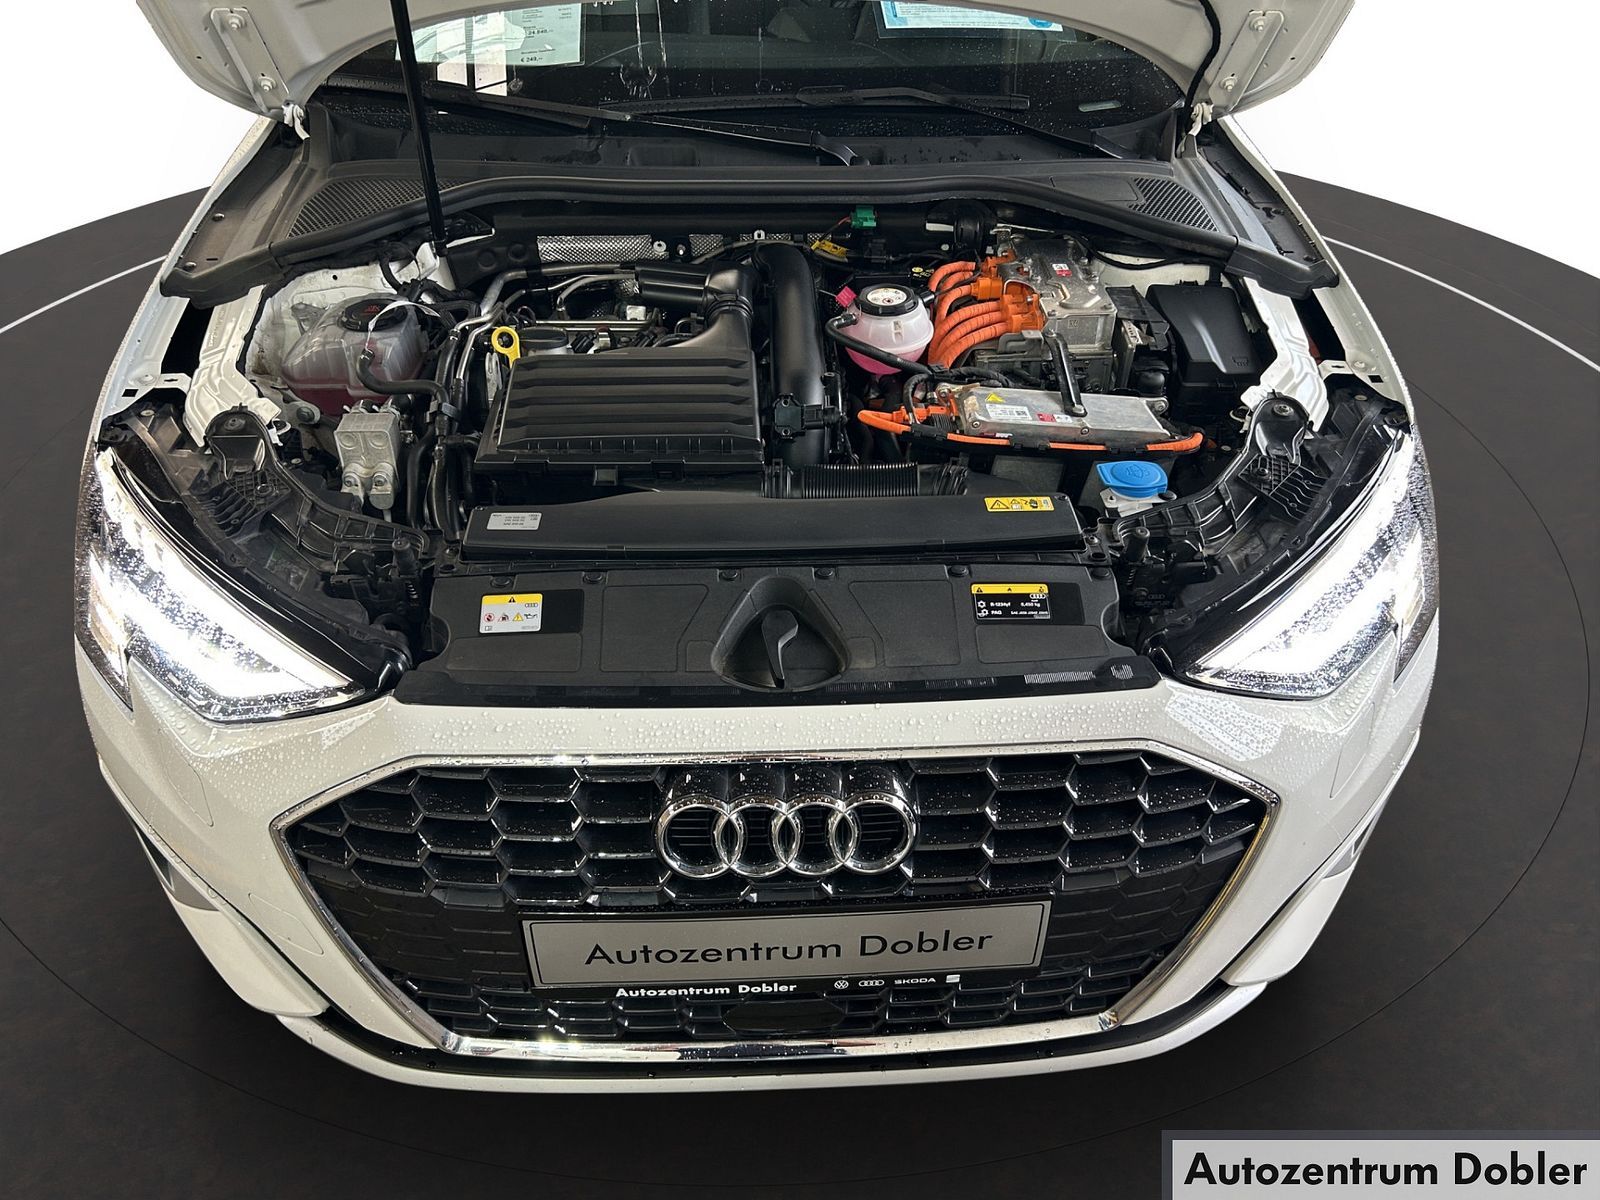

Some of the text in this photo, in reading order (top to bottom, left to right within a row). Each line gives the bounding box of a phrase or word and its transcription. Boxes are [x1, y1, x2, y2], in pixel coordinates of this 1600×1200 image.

[584, 929, 994, 966] Autozentrum Dobler
[615, 983, 798, 998] Autozentrum Dobler
